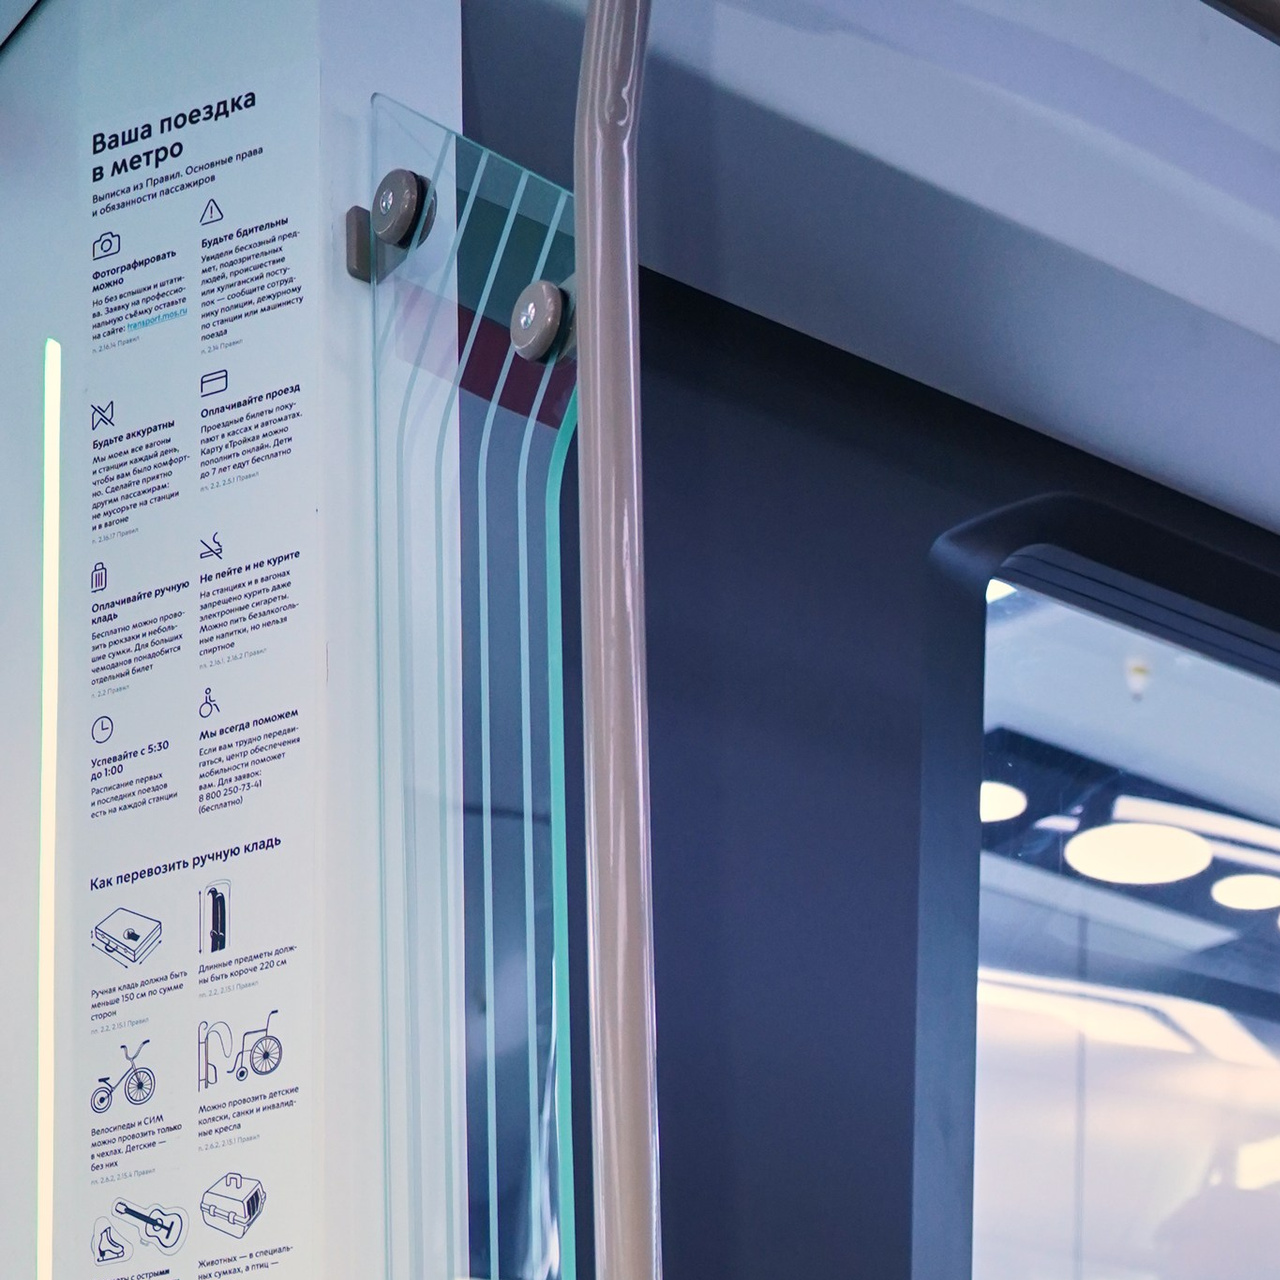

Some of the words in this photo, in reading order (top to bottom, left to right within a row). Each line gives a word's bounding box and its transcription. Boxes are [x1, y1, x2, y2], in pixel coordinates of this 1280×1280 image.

[92, 123, 152, 155] Ваша
[159, 91, 256, 134] поездка
[92, 165, 104, 183] в
[110, 141, 183, 177] метро
[92, 185, 131, 204] Выписка
[132, 182, 143, 191] из
[184, 155, 233, 175] Основные
[235, 146, 263, 162] права
[91, 209, 97, 217] и
[99, 191, 157, 215] обязанности
[158, 174, 215, 197] пассажиров
[201, 232, 234, 249] Будьте
[235, 217, 288, 238] бдительны
[200, 249, 233, 263] Увидели
[234, 234, 276, 253] бесхозный
[219, 245, 283, 269] подозрительных
[91, 250, 176, 280] Фотографировать
[229, 255, 285, 277] происшествие
[91, 276, 124, 293] можно
[200, 298, 215, 308] пок
[226, 284, 265, 301] сообщите
[92, 332, 101, 340] на
[126, 307, 187, 330] transport.mos.ru
[200, 328, 228, 341] поезда
[200, 394, 264, 418] Оплачивайте
[265, 383, 300, 400] проезд
[200, 416, 244, 433] Проездные
[245, 408, 274, 421] билеты
[92, 434, 124, 450] Будьте
[125, 419, 175, 440] аккуратны
[200, 444, 223, 456] Карту
[224, 434, 260, 449] «Тройка»
[261, 425, 289, 438] можно
[97, 460, 128, 474] станции
[129, 450, 158, 465] каждый
[199, 451, 240, 467] пополнить
[272, 436, 292, 448] Дети
[199, 470, 210, 480] до
[211, 466, 216, 475] 7
[217, 464, 231, 474] лет
[231, 459, 249, 470] едут
[250, 447, 292, 464] бесплатно
[91, 474, 114, 486] чтобы
[115, 471, 131, 480] вам
[132, 464, 152, 475] было
[91, 496, 119, 510] другим
[91, 512, 101, 520] не
[102, 502, 137, 518] мусорьте
[149, 490, 179, 504] станции
[199, 573, 213, 584] Не
[215, 565, 243, 579] пейте
[244, 563, 251, 571] и
[252, 560, 265, 569] не
[266, 550, 300, 567] курите
[91, 590, 152, 613] Оплачивайте
[154, 580, 190, 598] ручную
[199, 593, 242, 611] запрещено
[243, 587, 270, 600] курить
[270, 580, 291, 592] даже
[91, 612, 118, 625] кладь
[198, 620, 228, 633] Можно
[229, 616, 247, 625] пить
[199, 603, 250, 622] электронные
[91, 624, 130, 641] Бесплатно
[131, 617, 158, 629] можно
[91, 658, 132, 673] чемоданов
[133, 644, 181, 663] понадобится
[198, 641, 235, 656] спиртное
[90, 668, 130, 686] отдельный
[131, 663, 153, 675] билет
[198, 729, 217, 741] Мы
[218, 721, 250, 736] всегда
[252, 709, 298, 727] поможем
[90, 749, 138, 768] Успевайте
[139, 747, 145, 756] с
[147, 739, 169, 754] 5:30
[225, 749, 248, 761] центр
[249, 736, 300, 755] обеспечения
[90, 771, 102, 782] до
[103, 763, 123, 777] 1:00
[198, 761, 249, 779] мобильности
[250, 751, 285, 766] поможет
[90, 779, 134, 795] Расписание
[134, 772, 163, 784] первых
[198, 793, 204, 803] 8
[205, 789, 221, 801] 800
[222, 778, 262, 797] 250-73-41
[216, 776, 232, 787] Для
[198, 794, 243, 815] (бесплатно)
[90, 876, 113, 891] Как
[115, 859, 189, 885] перевозить
[192, 845, 240, 869] ручную
[243, 836, 281, 853] кладь
[209, 973, 228, 982] быть
[229, 965, 258, 977] короче
[259, 959, 275, 971] 220
[275, 958, 287, 967] см
[91, 997, 120, 1009] меньше
[121, 991, 135, 1002] 150
[135, 991, 146, 999] см
[147, 988, 157, 996] по
[158, 982, 184, 995] сумме
[90, 1009, 117, 1021] сторон
[198, 1101, 227, 1114] Можно
[227, 1093, 267, 1108] провозить
[268, 1085, 299, 1099] детские
[90, 1121, 136, 1137] Велосипеды
[142, 1113, 164, 1126] СИМ
